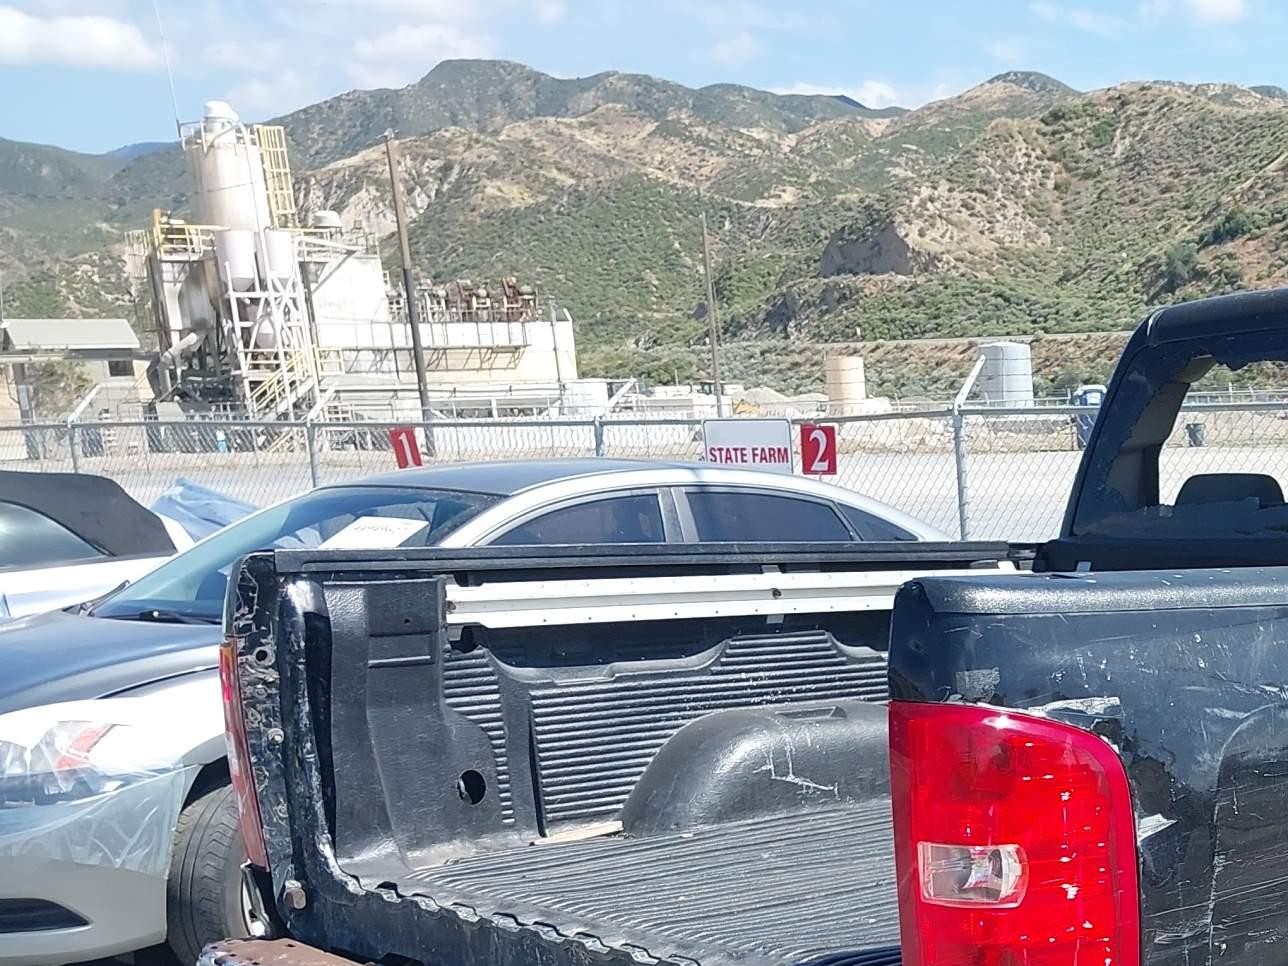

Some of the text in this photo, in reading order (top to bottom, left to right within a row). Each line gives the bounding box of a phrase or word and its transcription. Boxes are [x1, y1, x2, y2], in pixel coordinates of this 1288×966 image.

[398, 431, 416, 468] 1
[708, 447, 789, 463] STATE FARM
[808, 429, 829, 471] 2
